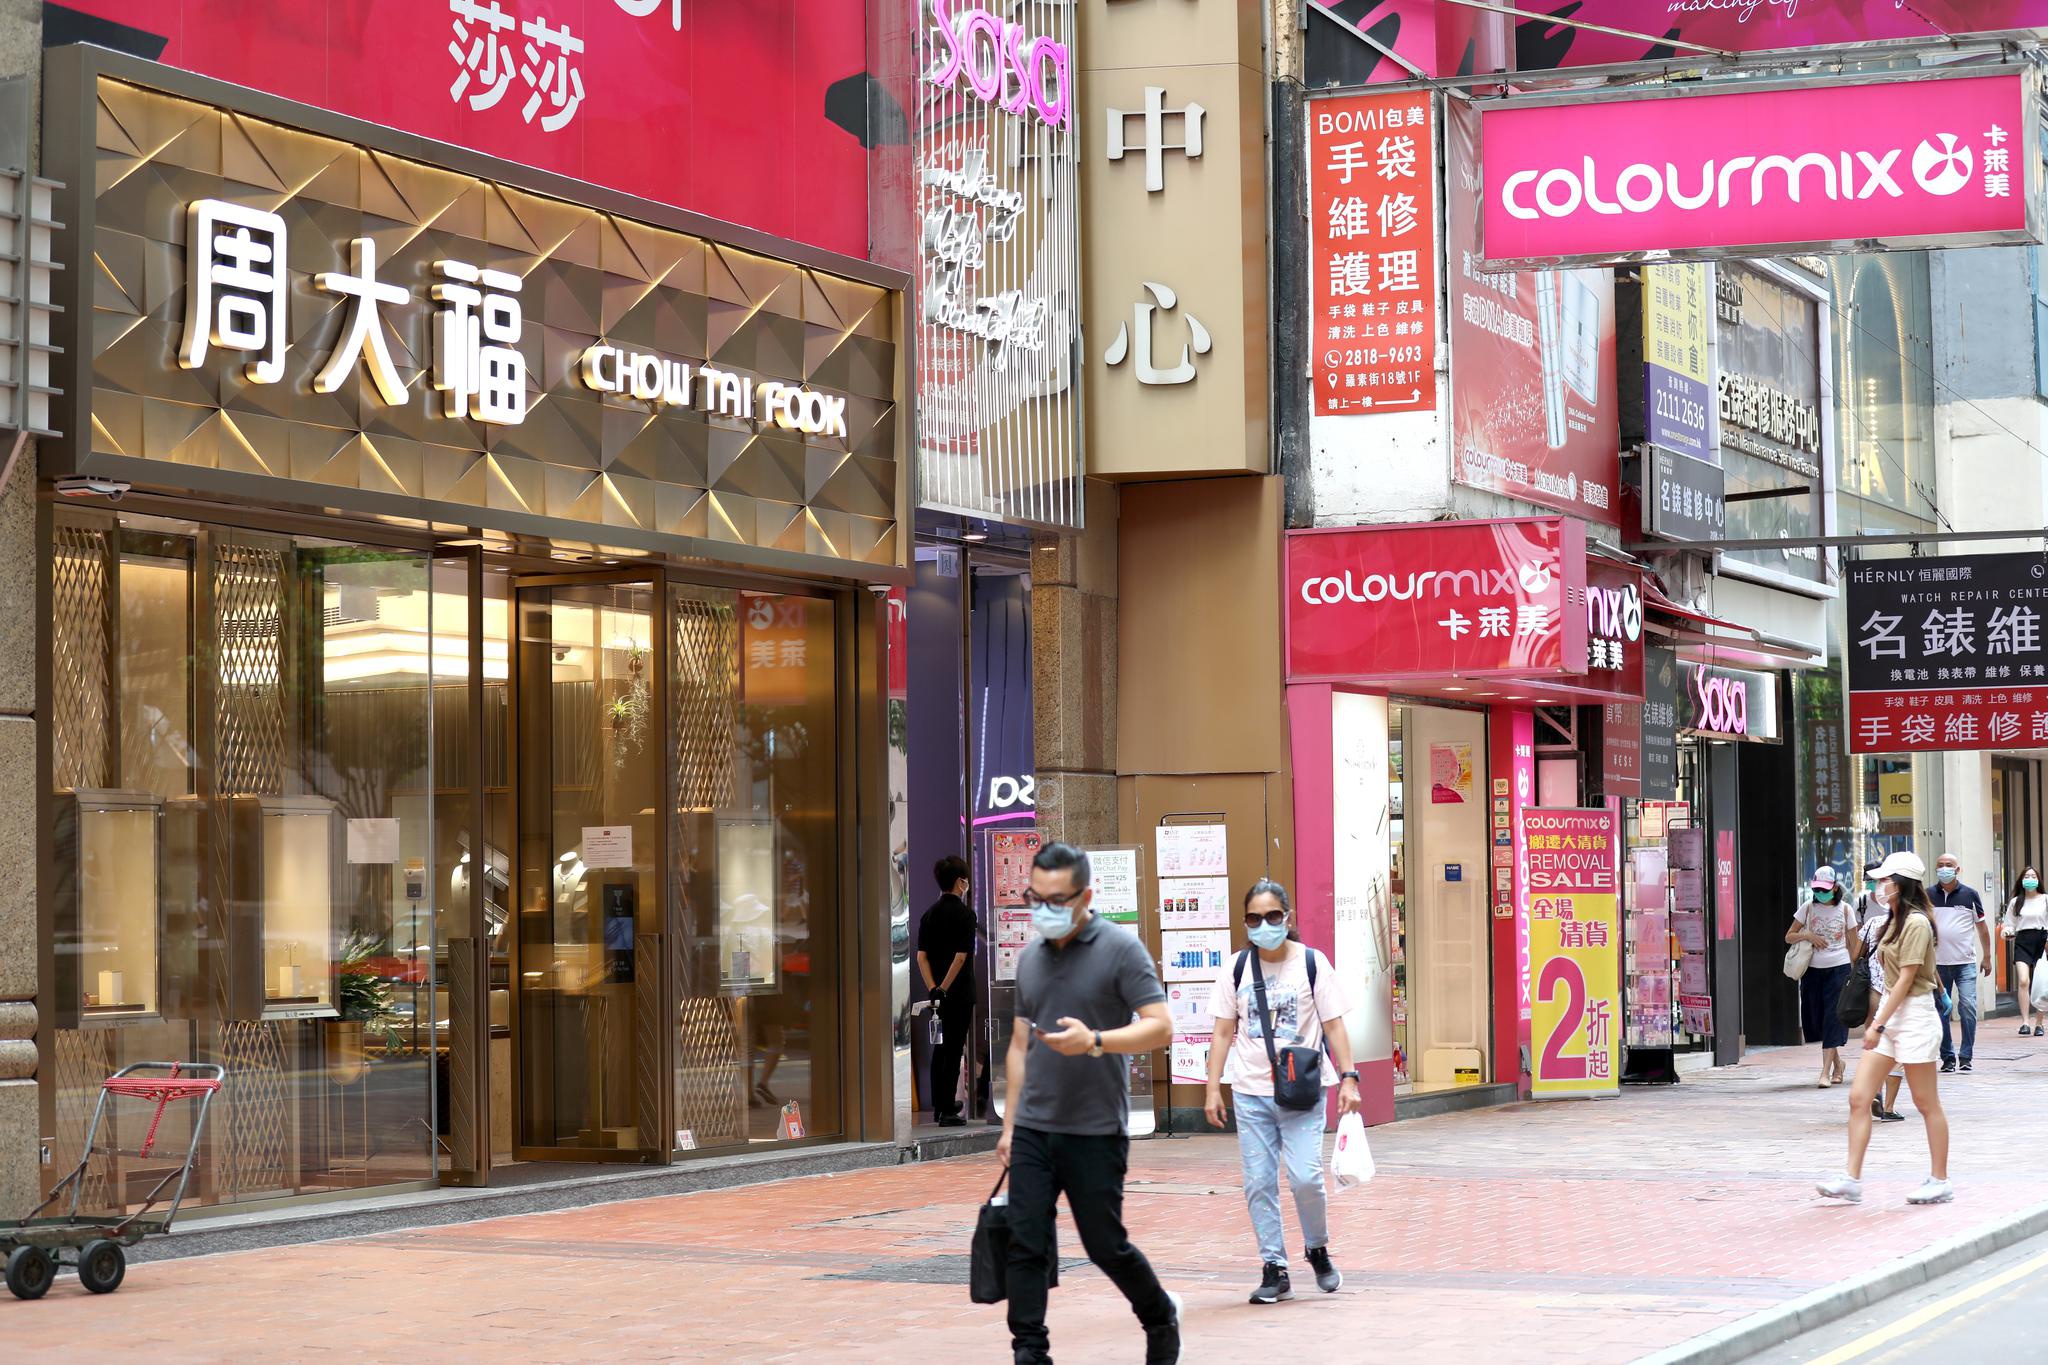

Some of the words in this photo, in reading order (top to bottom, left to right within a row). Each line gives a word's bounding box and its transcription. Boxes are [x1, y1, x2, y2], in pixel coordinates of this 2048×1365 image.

[449, 0, 585, 132] 莎莎
[1327, 135, 1416, 185] 手袋
[1983, 123, 2011, 199] 卡萊美
[1328, 192, 1419, 240] 維修
[1329, 250, 1420, 297] 護理
[179, 199, 526, 426] 周大福
[1328, 304, 1356, 319] 手袋
[1361, 302, 1390, 317] 鞋子
[1396, 299, 1424, 315] 皮具
[1327, 324, 1355, 340] 清洗
[1361, 322, 1390, 338] 上色
[1395, 320, 1424, 336] 維修
[1345, 345, 1422, 366] 2818-9693
[582, 345, 690, 406] CHOW
[696, 367, 751, 418] TAI
[756, 382, 846, 438] FOOK
[1328, 396, 1373, 410] 請上一樓
[1656, 389, 1681, 422] 2111
[1681, 398, 1705, 431] 2636
[1660, 479, 1724, 528] 名錶維修中心
[1918, 566, 1972, 582] 恒麗國際
[1901, 592, 1941, 604] WATCH
[1951, 590, 1999, 601] REPAIR
[1438, 605, 1549, 641] 卡萊美
[1858, 605, 2042, 660] 名錶維
[1890, 668, 1929, 682] 換電池
[1937, 666, 1977, 680] 換表帶
[1985, 665, 2011, 678] 維修
[2019, 664, 2045, 678] 保養
[1884, 696, 1904, 708] 手袋
[1909, 695, 1929, 707] 鞋子
[1934, 694, 1954, 706] 皮具
[1962, 694, 1982, 705] 清洗
[1988, 693, 2007, 704] 上色
[2012, 692, 2033, 703] 維修
[1530, 853, 1611, 870] REMOVAL
[1530, 872, 1612, 888] SALE
[1533, 898, 1574, 920] 全場
[1560, 921, 1608, 948] 清貨
[1537, 956, 1587, 1080] 2
[1586, 999, 1610, 1078] 折起
